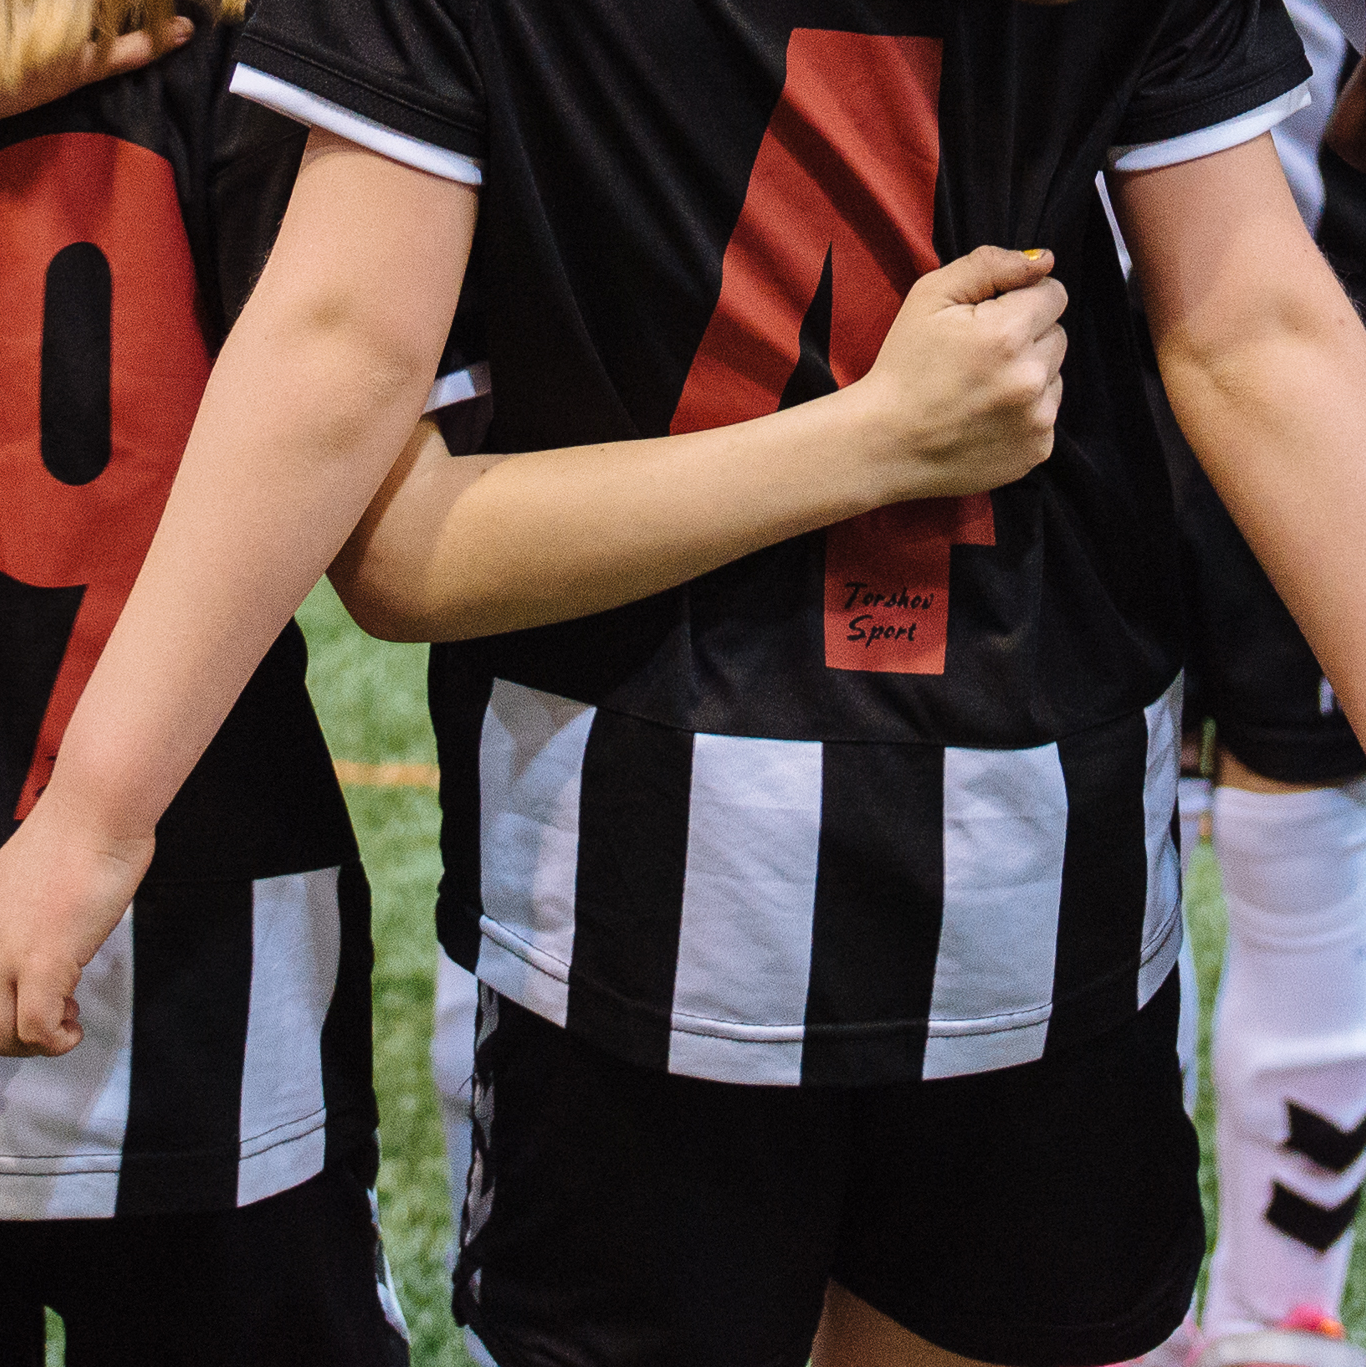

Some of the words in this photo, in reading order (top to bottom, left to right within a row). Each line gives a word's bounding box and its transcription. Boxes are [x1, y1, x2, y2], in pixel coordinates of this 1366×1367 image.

[668, 27, 996, 675] 4
[844, 582, 935, 610] Torshov
[846, 614, 917, 648] Sport
